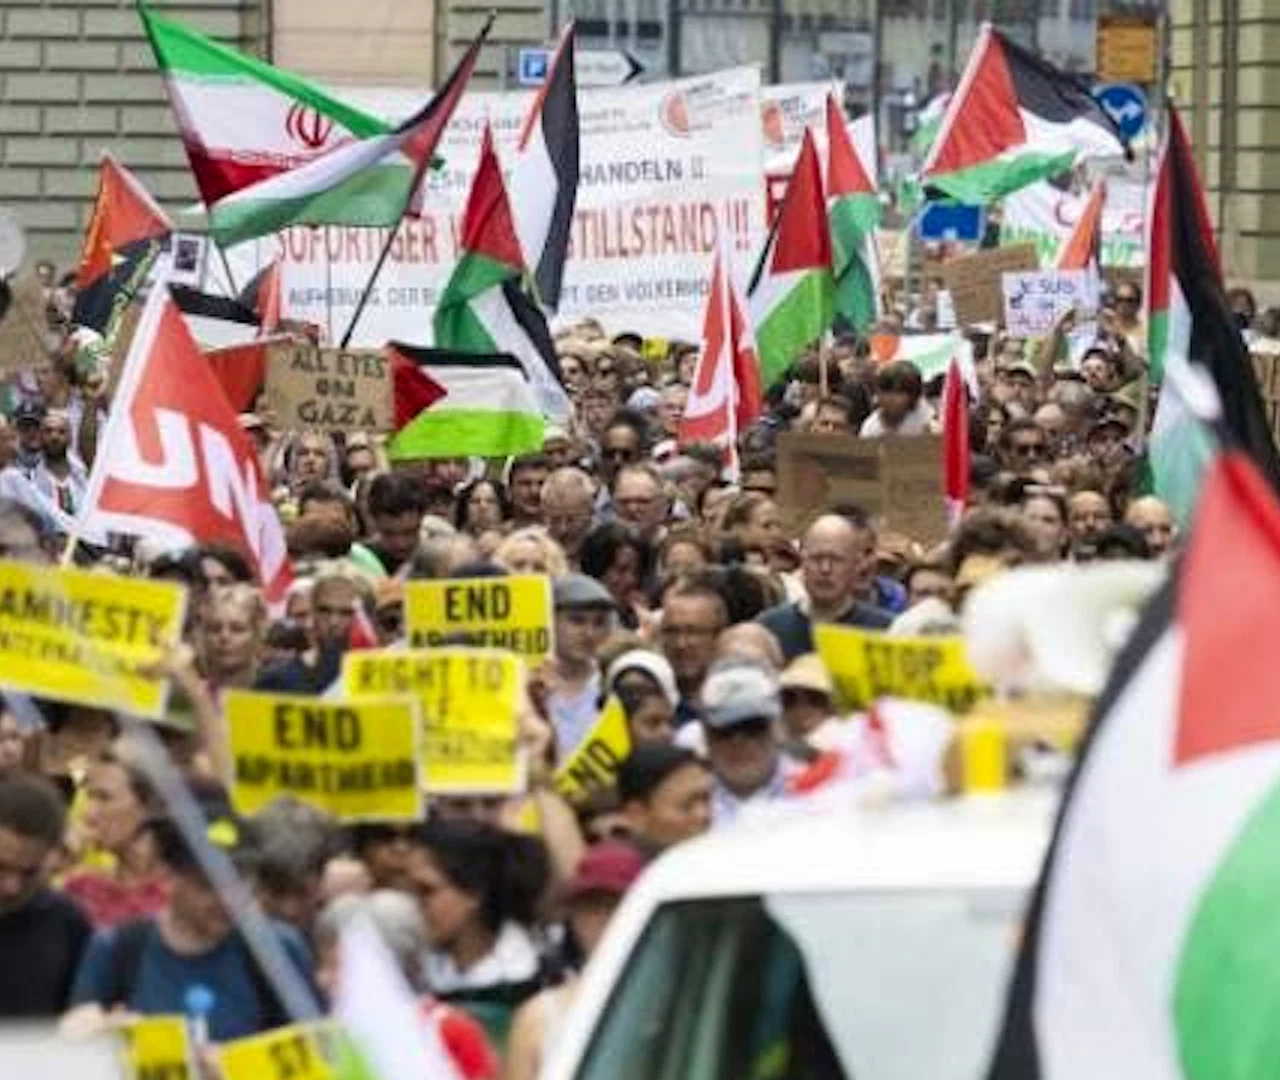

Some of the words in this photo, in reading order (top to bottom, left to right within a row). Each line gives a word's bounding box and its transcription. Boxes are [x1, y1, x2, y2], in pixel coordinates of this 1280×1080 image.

[291, 350, 328, 372] ALL
[297, 401, 376, 426] GAZA
[445, 584, 511, 622] END
[358, 656, 452, 694] RIGHT
[465, 658, 503, 691] TO
[273, 704, 361, 751] END
[236, 756, 415, 791] APARTHEID
